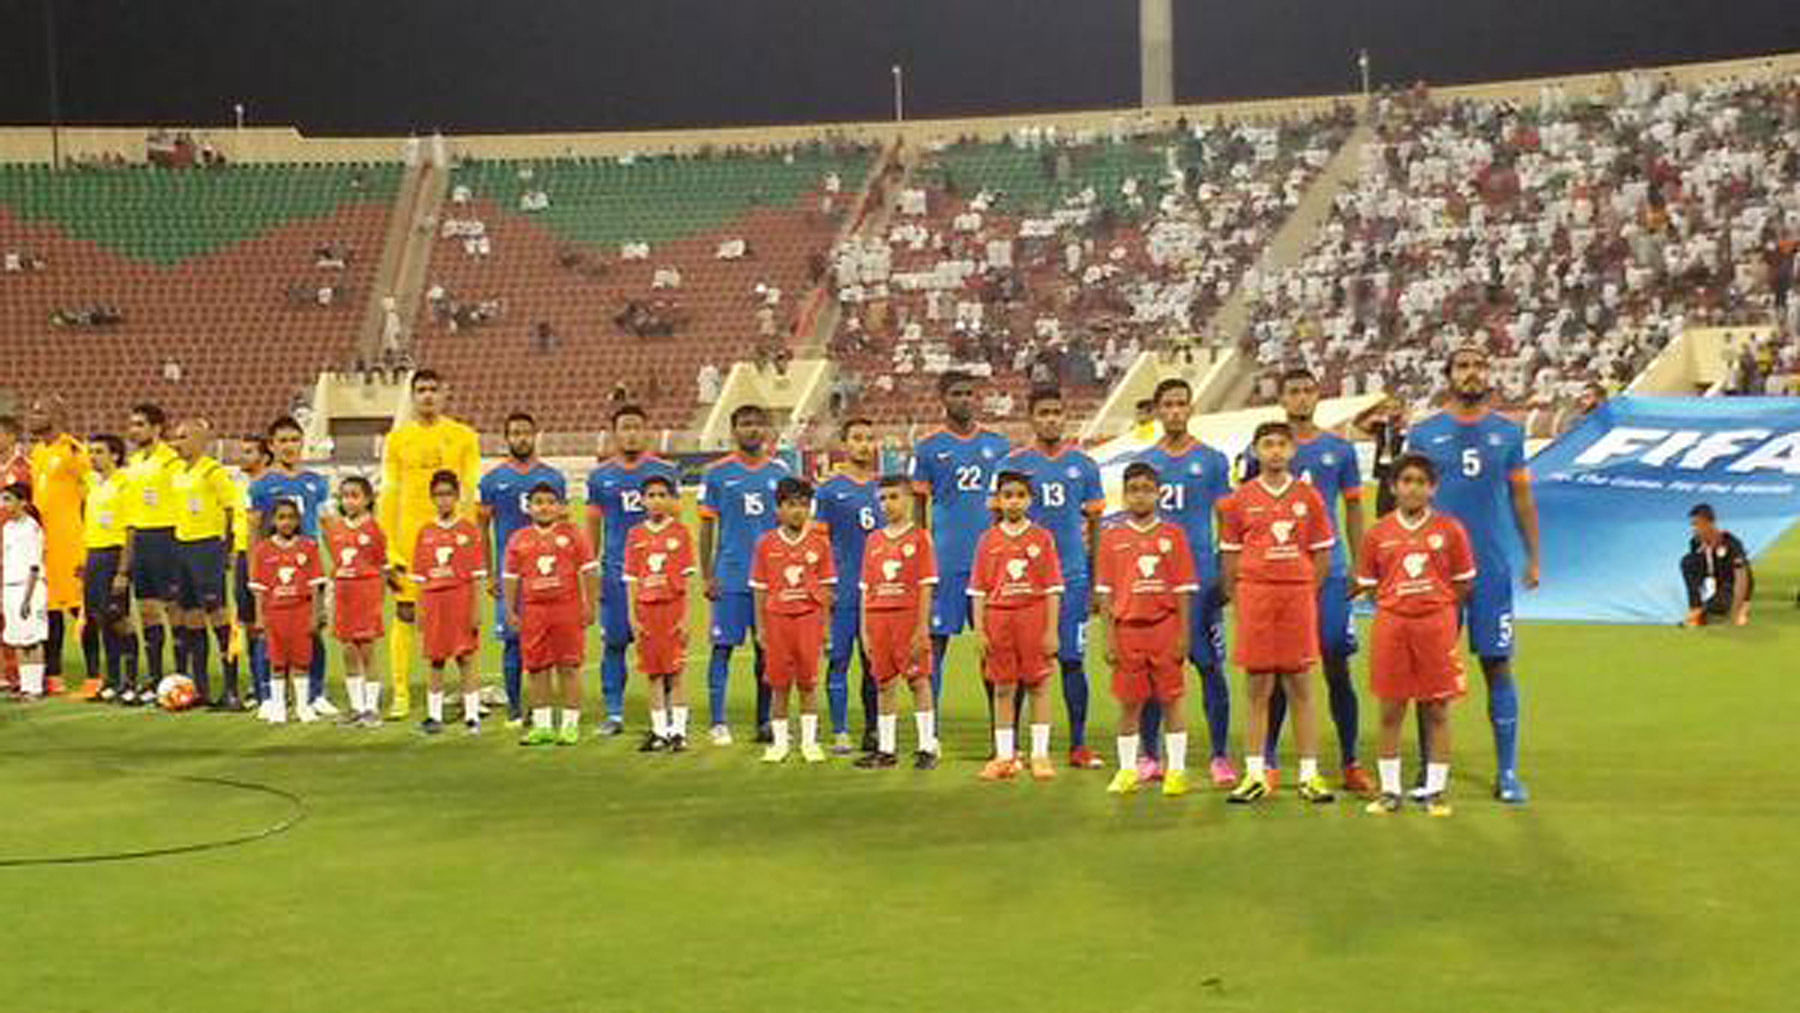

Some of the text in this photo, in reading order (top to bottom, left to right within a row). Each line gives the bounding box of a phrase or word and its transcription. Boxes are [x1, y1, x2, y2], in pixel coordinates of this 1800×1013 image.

[1574, 427, 1800, 472] FIFA
[1462, 449, 1480, 476] 5
[956, 466, 981, 490] 22
[621, 490, 643, 511] 12
[743, 493, 764, 515] 15
[1042, 483, 1065, 506] 13
[1160, 484, 1183, 510] 21
[860, 507, 875, 529] 6
[1499, 613, 1514, 648] 5
